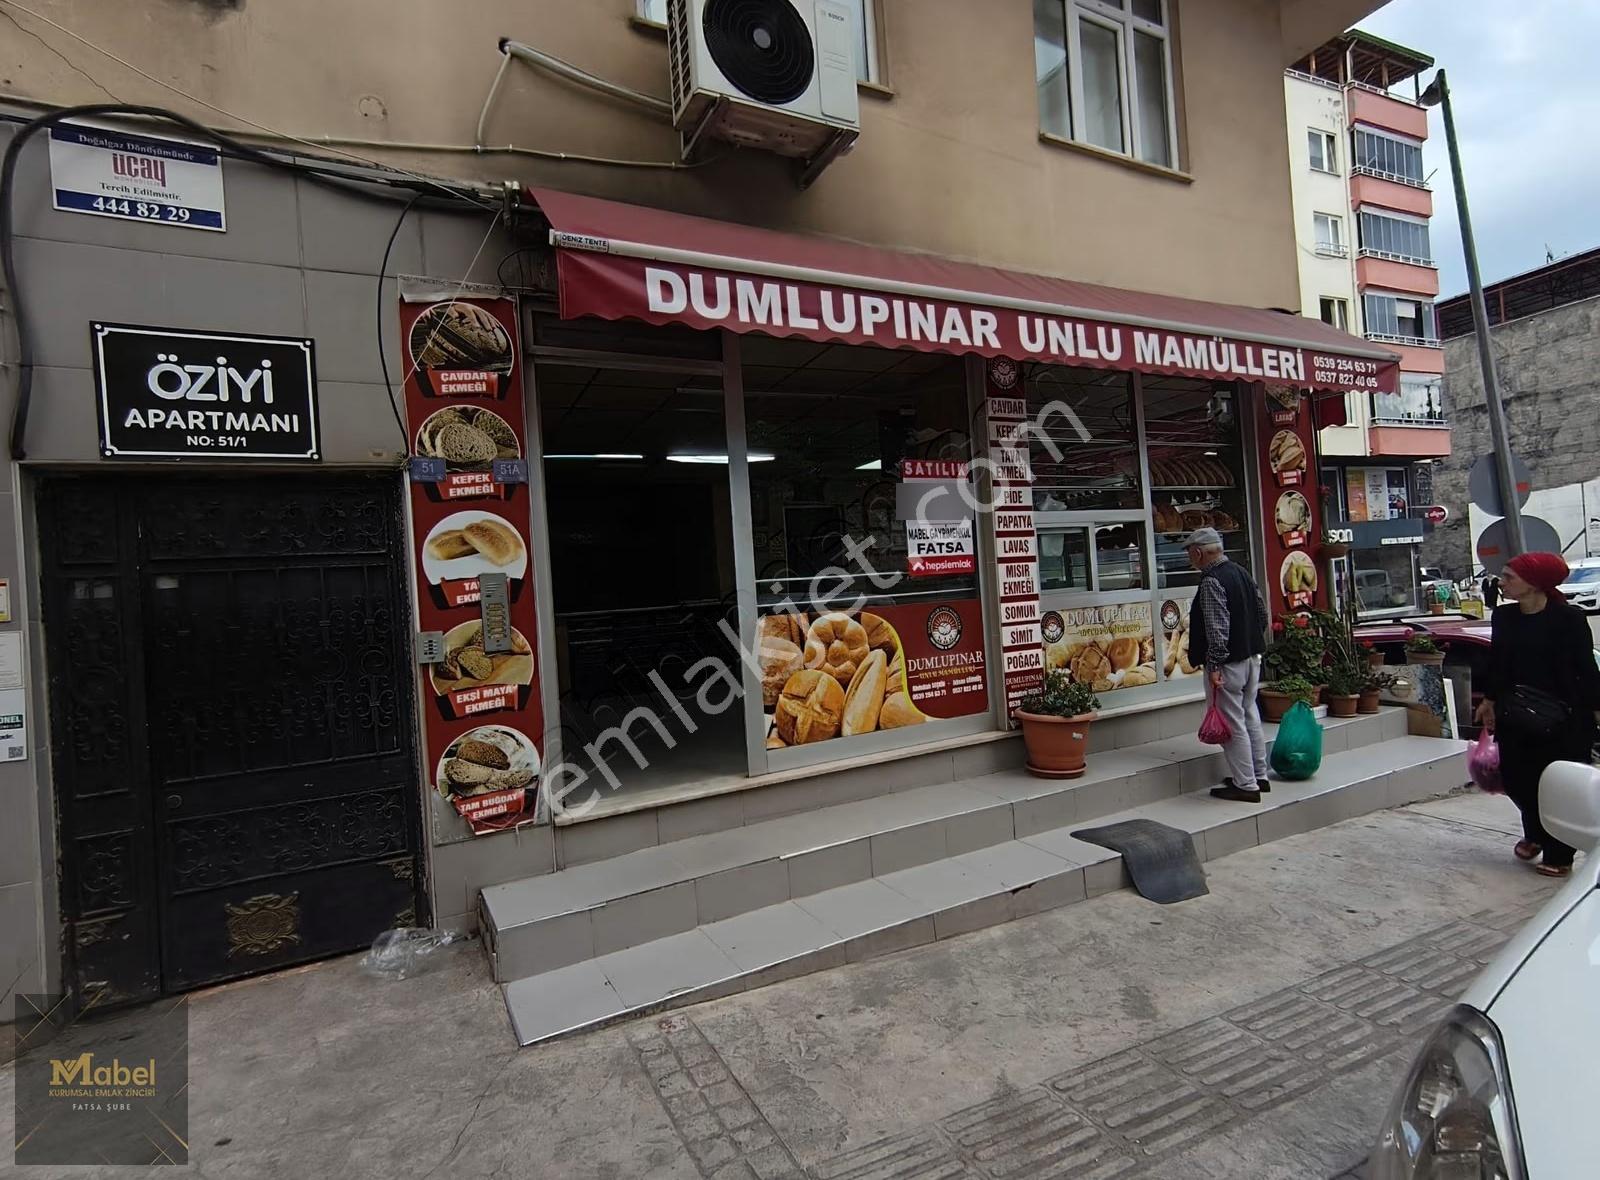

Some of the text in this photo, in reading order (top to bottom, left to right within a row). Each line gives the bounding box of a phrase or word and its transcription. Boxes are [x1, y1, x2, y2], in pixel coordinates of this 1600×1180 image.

[79, 134, 124, 150] Doğalgaz
[100, 182, 130, 194] Tercih
[93, 197, 131, 215] 444
[136, 203, 160, 219] 82
[168, 206, 190, 221] 29
[583, 237, 607, 247] TENTE
[645, 267, 1305, 380] DUMLUPINAR UNLU MAMÜLLERİ
[1313, 356, 1377, 374] 0539 254 63 71
[440, 372, 488, 382] ÇAVDAR
[1315, 370, 1378, 388] 0537 823 40 05
[441, 382, 487, 393] EKMEĞİ
[991, 400, 1024, 415] ÇAVDAR
[124, 408, 299, 433] APARTMANI
[996, 424, 1023, 438] KEPEK
[186, 436, 247, 447] NO: 51/1
[422, 463, 434, 473] 51
[500, 464, 520, 475] 51A
[905, 461, 968, 476] SATILIK
[452, 473, 490, 485] KEPEK
[449, 483, 494, 497] EKMEĞİ
[1004, 488, 1023, 504] PİDE
[998, 515, 1033, 529] PAPATYA
[908, 528, 930, 540] MABEL
[917, 542, 965, 555] FATSA
[1004, 539, 1030, 554] LAVAŞ
[925, 559, 972, 571] hepsiemlak
[1005, 565, 1030, 579] MISIR
[1003, 578, 1034, 595] EKMEĞİ
[1005, 605, 1036, 620] SOMUN
[1010, 628, 1034, 645] SİMİT
[907, 650, 984, 672] DUMLUPINAR
[1007, 652, 1041, 670] POĞAÇA
[456, 685, 513, 704] EKŞİ MAYA
[465, 698, 506, 715] EKMEĞİ
[460, 793, 518, 812] TAM BUĞDAY
[472, 804, 507, 819] EKMEĞİ
